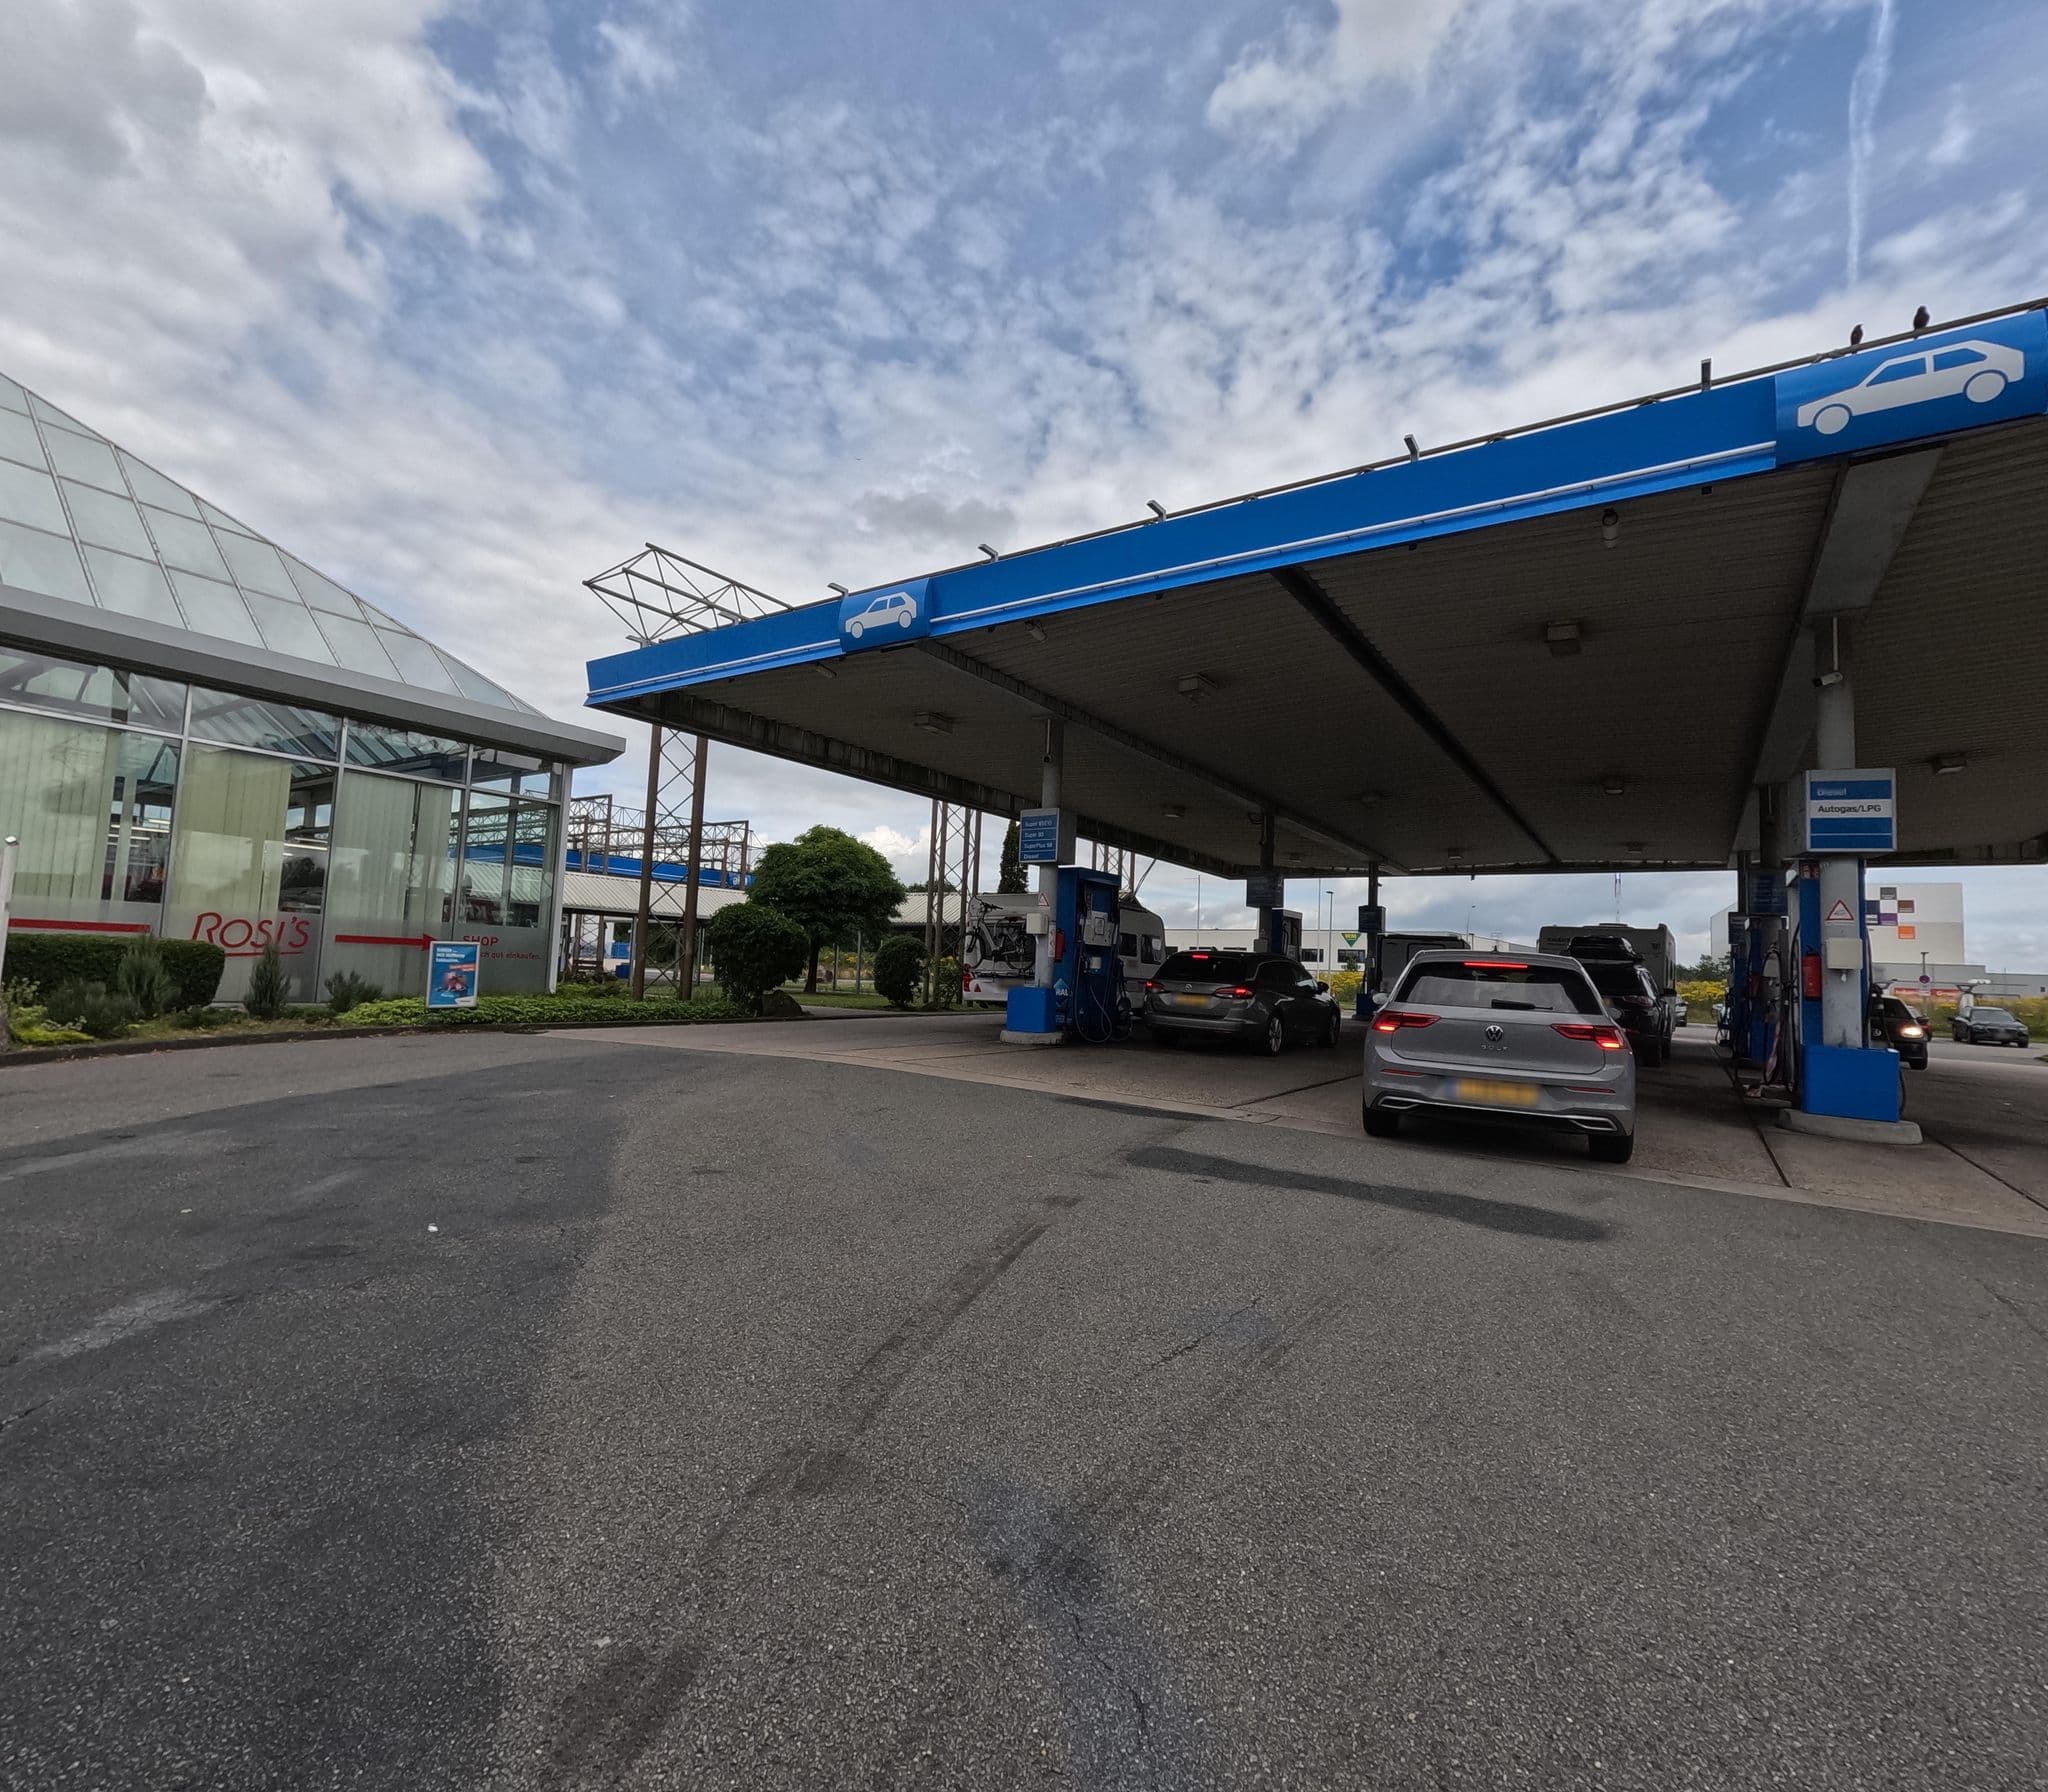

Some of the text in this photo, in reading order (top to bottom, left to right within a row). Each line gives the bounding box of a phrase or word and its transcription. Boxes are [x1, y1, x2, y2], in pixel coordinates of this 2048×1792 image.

[1817, 787, 1847, 797] Diesel
[1818, 804, 1882, 813] Autogas/LPG
[191, 912, 310, 948] ROSI'S
[463, 935, 499, 946] SHOP
[1055, 987, 1070, 997] RAL
